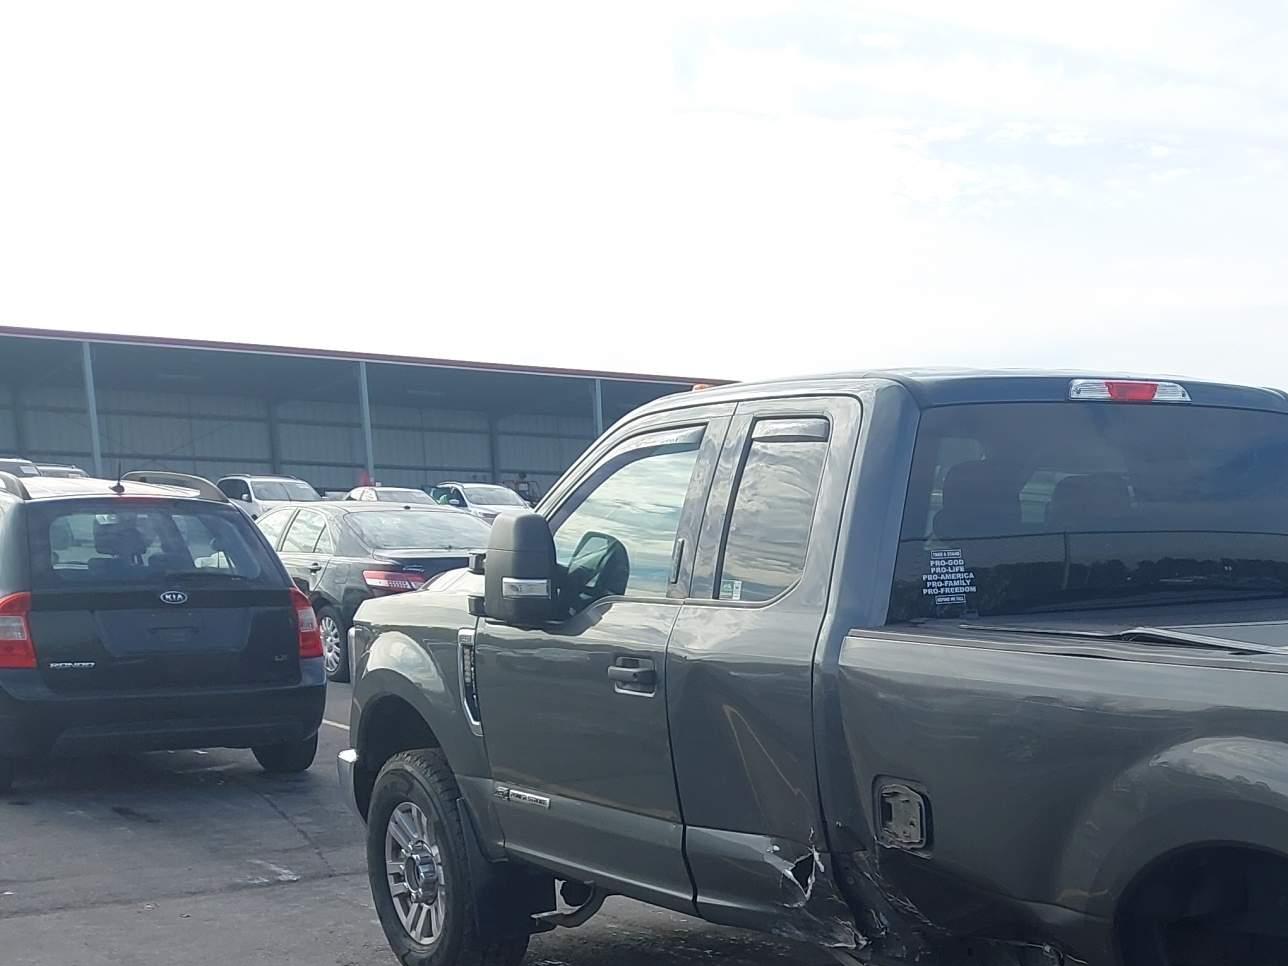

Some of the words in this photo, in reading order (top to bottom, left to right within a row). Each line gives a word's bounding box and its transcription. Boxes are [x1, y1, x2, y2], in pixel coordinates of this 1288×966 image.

[930, 559, 964, 567] PRO-GOD
[930, 566, 965, 574] PRO-LIFE
[922, 572, 975, 581] PRO-AMERICA
[926, 579, 971, 588] PRO-FAMILY
[922, 586, 977, 595] PRO-FREEDOM
[162, 592, 185, 602] KIA
